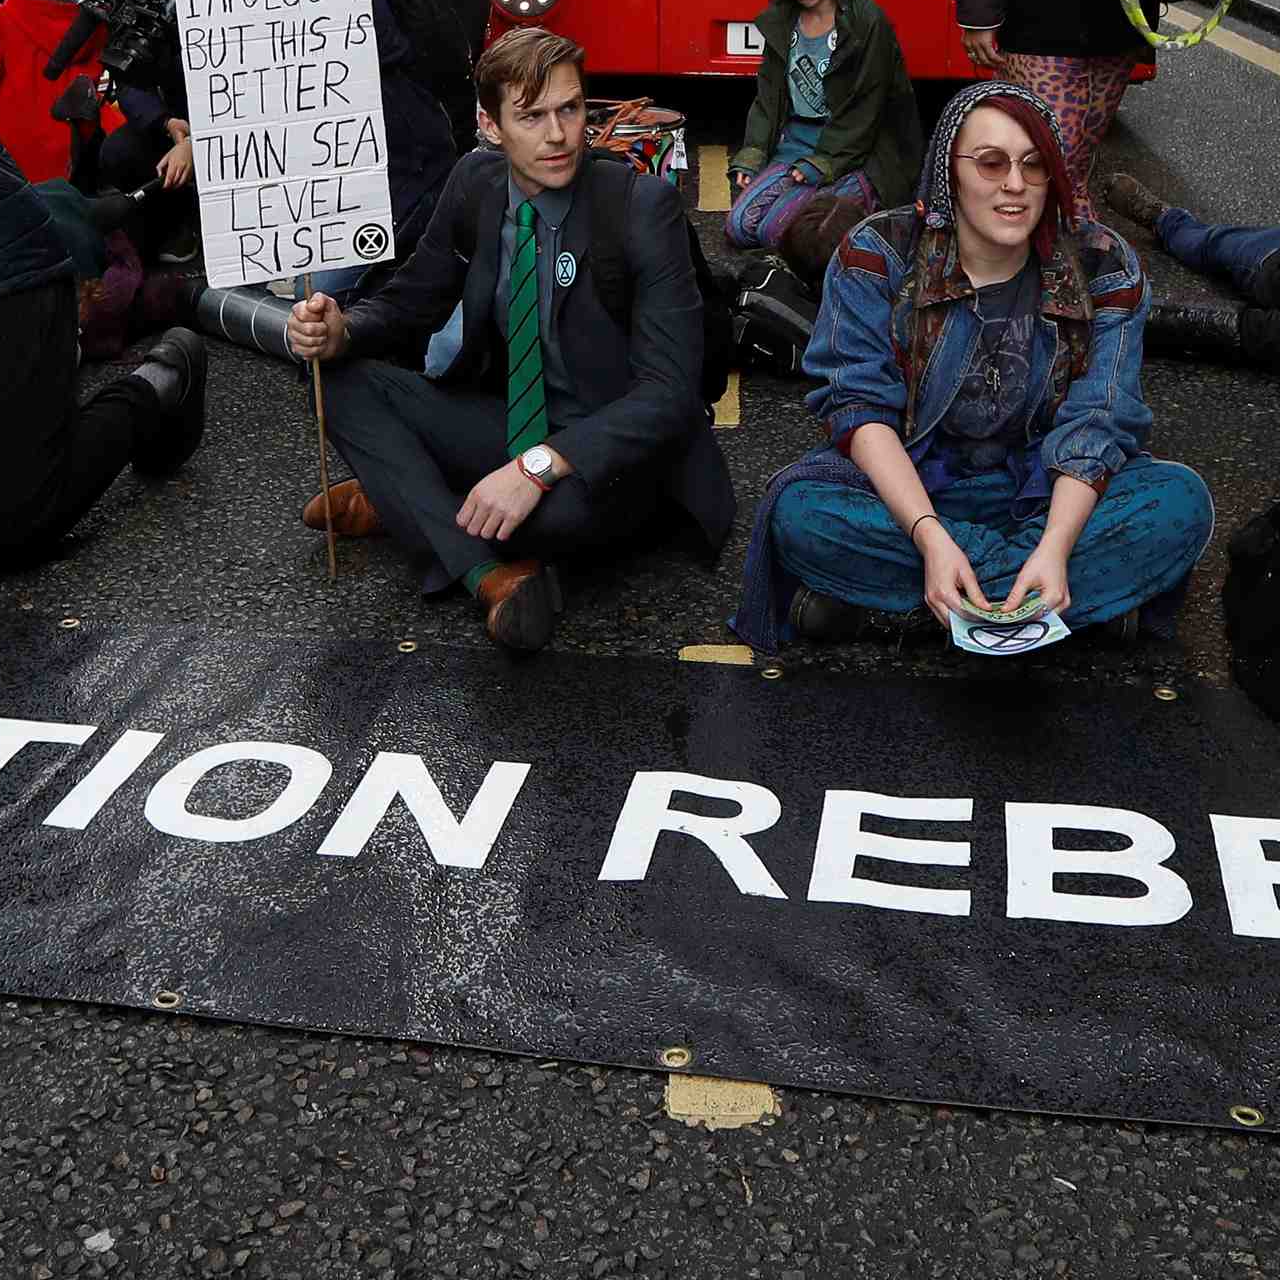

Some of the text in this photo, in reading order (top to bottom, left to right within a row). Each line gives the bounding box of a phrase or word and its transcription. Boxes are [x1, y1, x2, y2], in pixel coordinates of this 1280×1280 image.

[185, 13, 372, 71] BUT THIS IS
[208, 60, 351, 123] BETTER
[196, 116, 380, 182] THAN SEA
[230, 175, 361, 232] LEVEL
[238, 221, 347, 281] RISE
